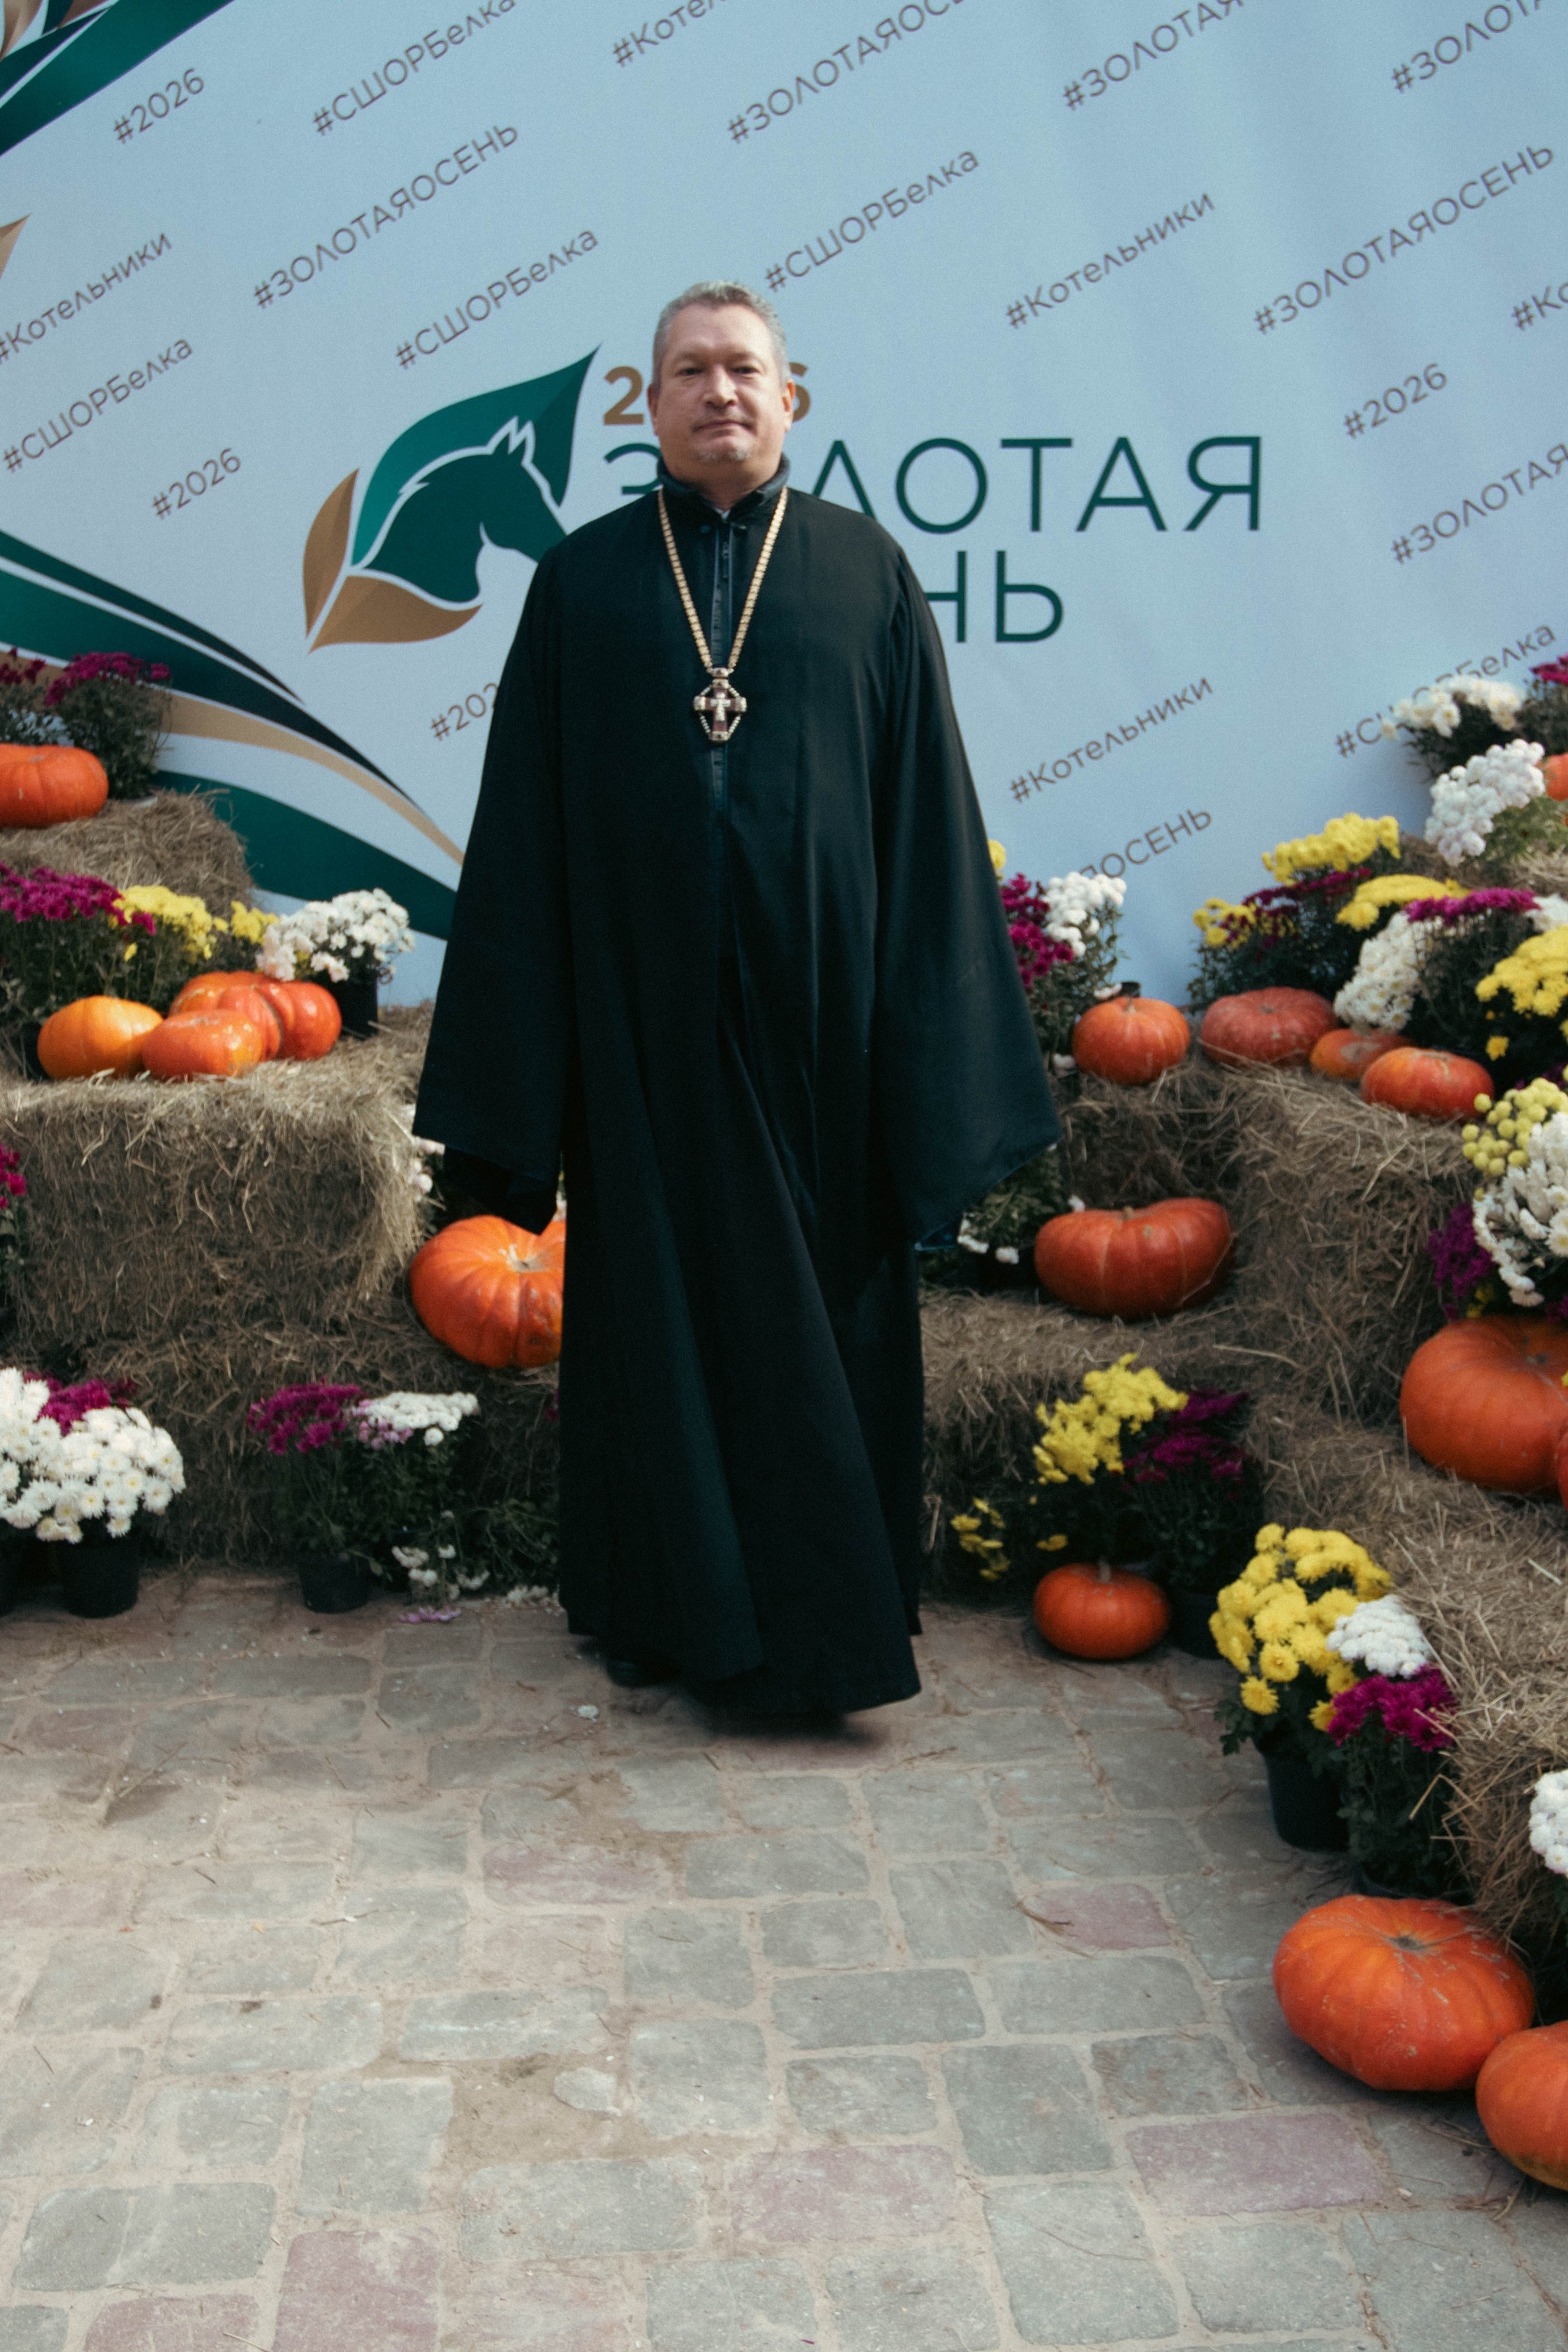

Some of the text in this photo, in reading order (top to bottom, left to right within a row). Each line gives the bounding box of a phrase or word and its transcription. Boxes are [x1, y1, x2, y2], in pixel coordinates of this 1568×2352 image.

[113, 67, 205, 144] #2026
[312, 0, 516, 136] #СШОРБелка
[727, 0, 963, 144] #ЗОЛОТАЯОС
[253, 125, 518, 309] #ЗОЛОТАЯОСЕНЬ
[766, 150, 979, 292] #СШОРБелка
[1006, 193, 1215, 329] #Котельники
[1254, 146, 1554, 334] #ЗОЛОТАЯОСЕНЬ
[396, 229, 599, 370] #СШОРБелка
[3, 339, 192, 473] #СШОРБелка
[1343, 363, 1447, 439] #2026
[152, 447, 241, 519] #2026
[1009, 677, 1213, 804] #Котельники
